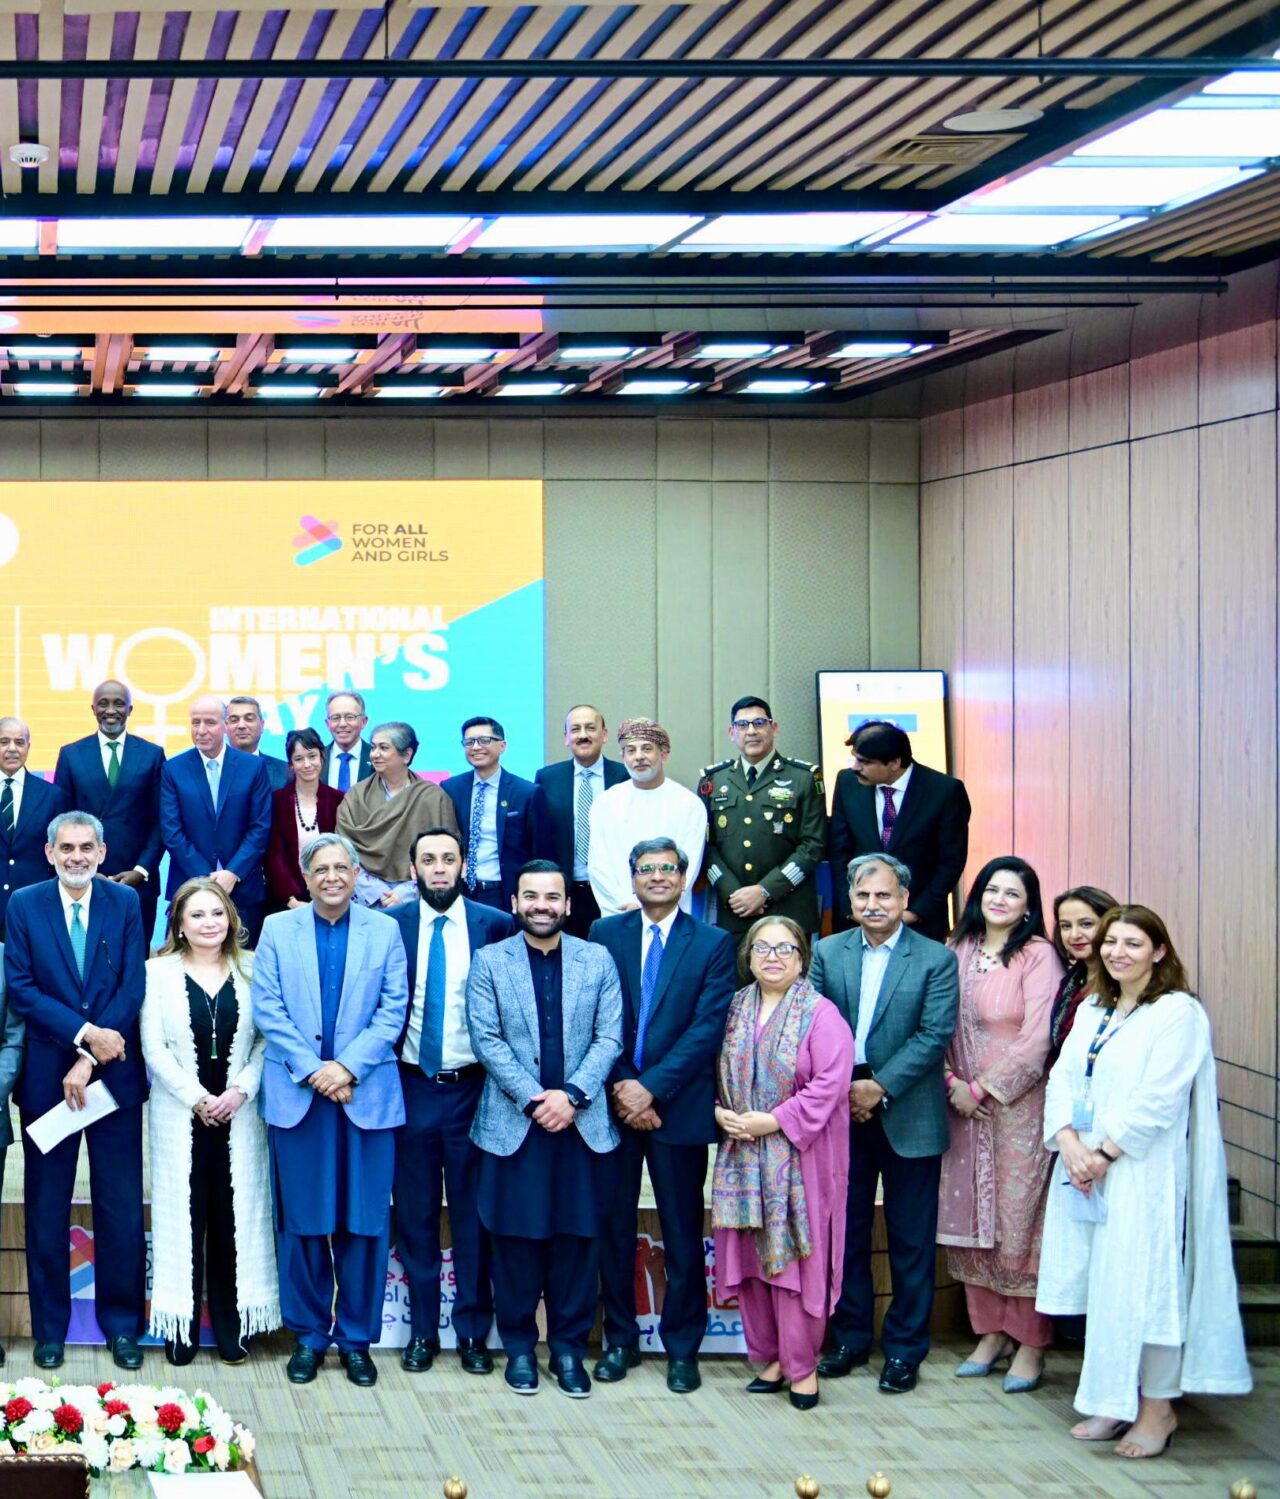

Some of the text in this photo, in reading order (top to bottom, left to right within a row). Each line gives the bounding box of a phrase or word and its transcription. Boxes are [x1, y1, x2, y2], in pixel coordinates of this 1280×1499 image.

[352, 523, 429, 536] FOR ALL
[352, 537, 426, 549] WOMEN
[351, 550, 449, 562] AND GIRLS
[209, 606, 449, 632] INTERNATIONAL
[224, 695, 319, 735] AY
